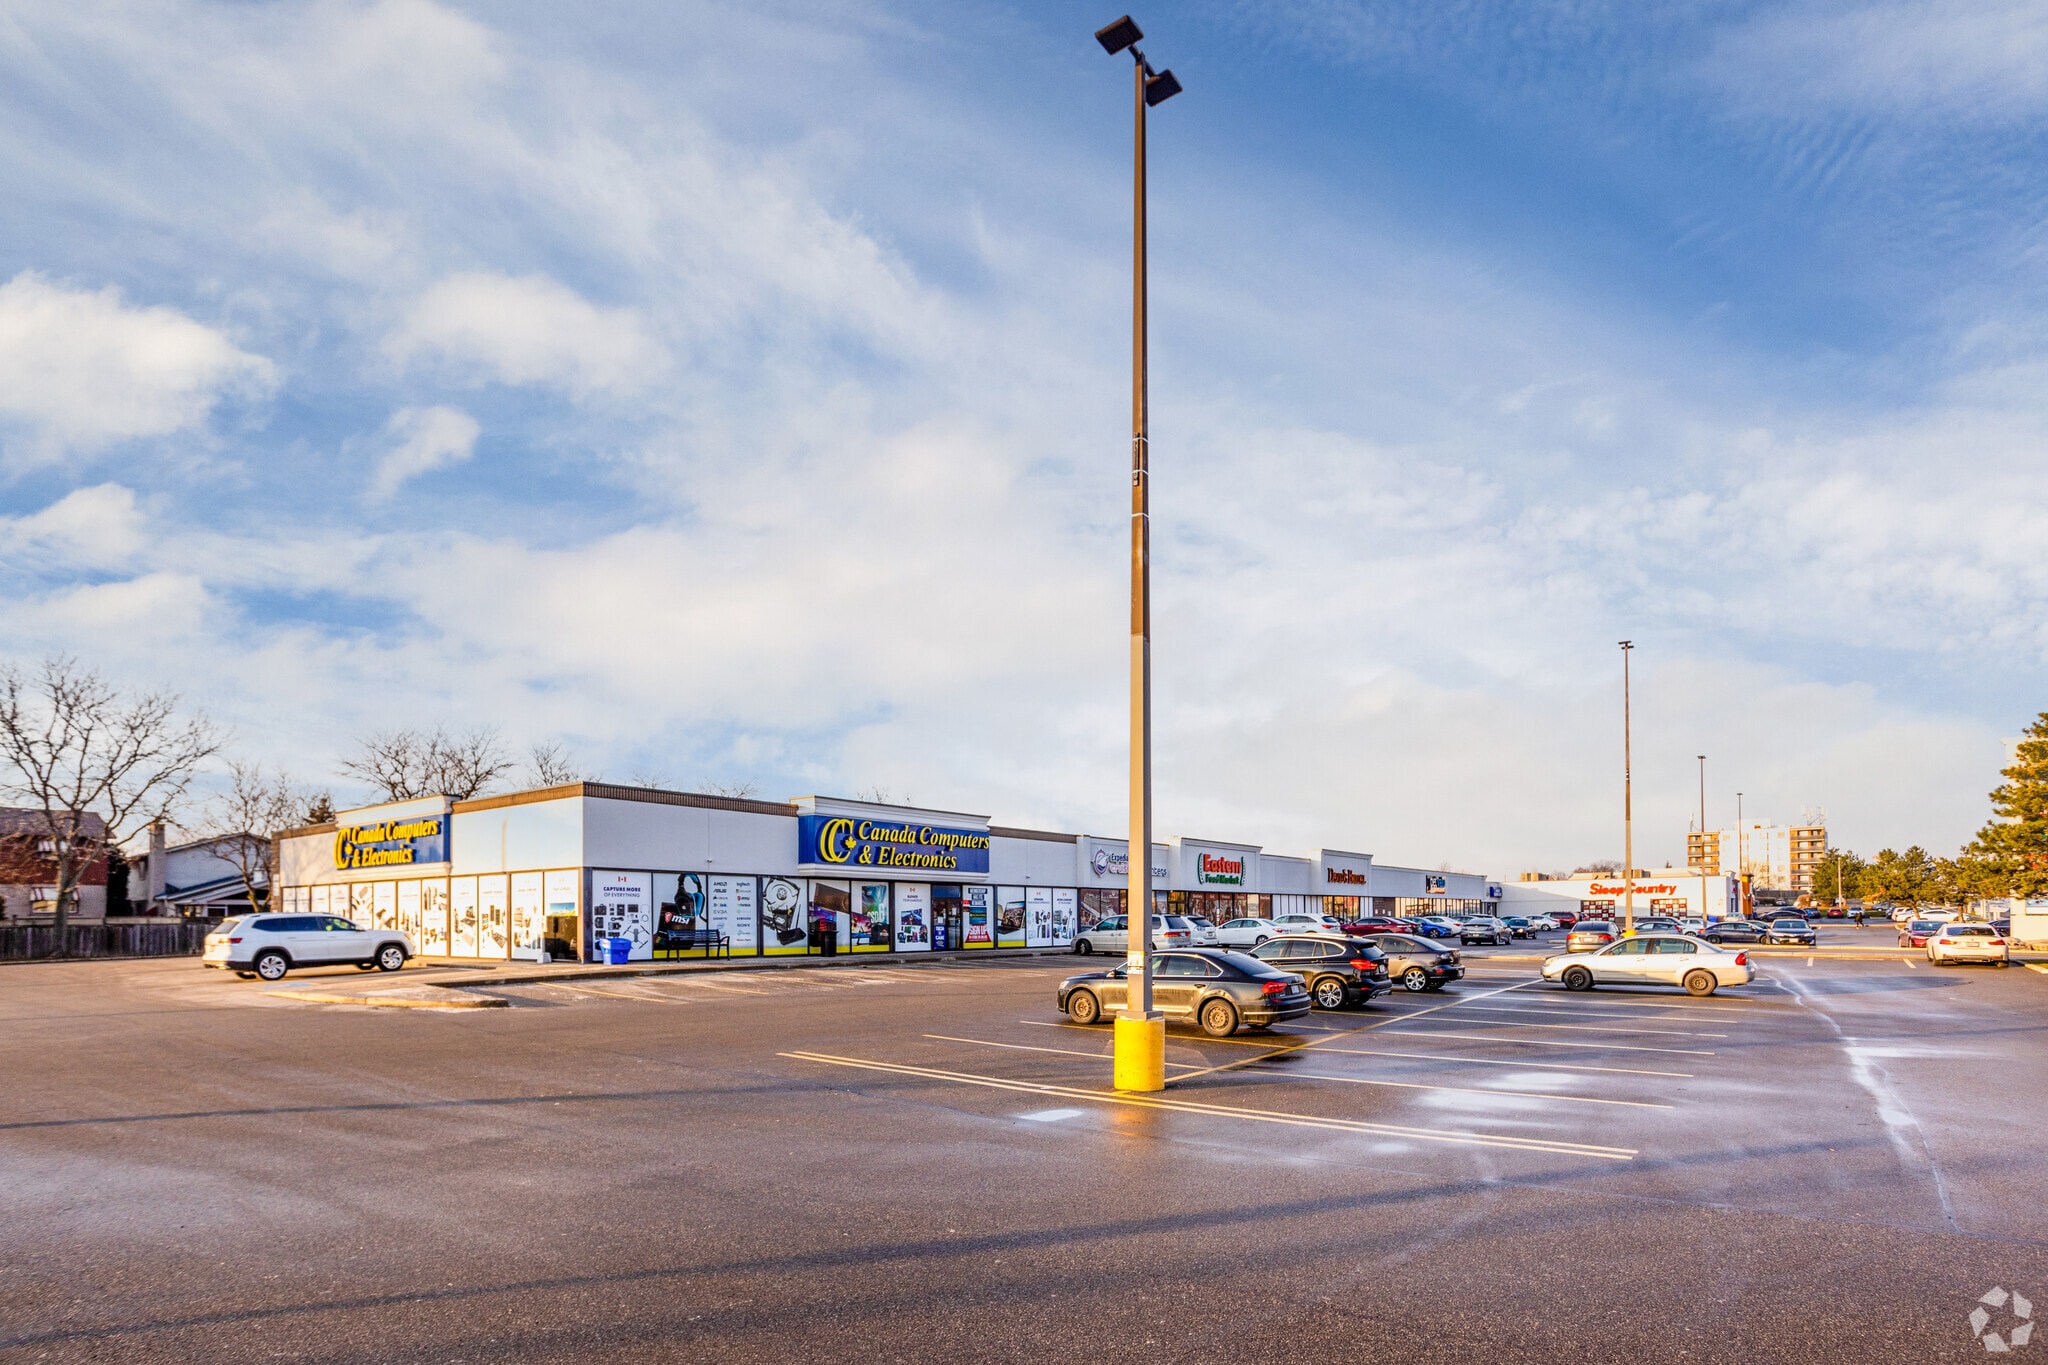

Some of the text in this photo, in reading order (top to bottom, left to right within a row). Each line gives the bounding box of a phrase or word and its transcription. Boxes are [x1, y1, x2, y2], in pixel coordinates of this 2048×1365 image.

[352, 821, 438, 845] Canada Computers
[858, 821, 990, 851] Canada Computers
[352, 844, 413, 867] & Electronics
[859, 844, 957, 869] & Electronics
[1111, 853, 1129, 861] Expedi
[1203, 854, 1241, 874] Eastern
[1589, 883, 1624, 896] Sleep
[671, 914, 690, 925] msi
